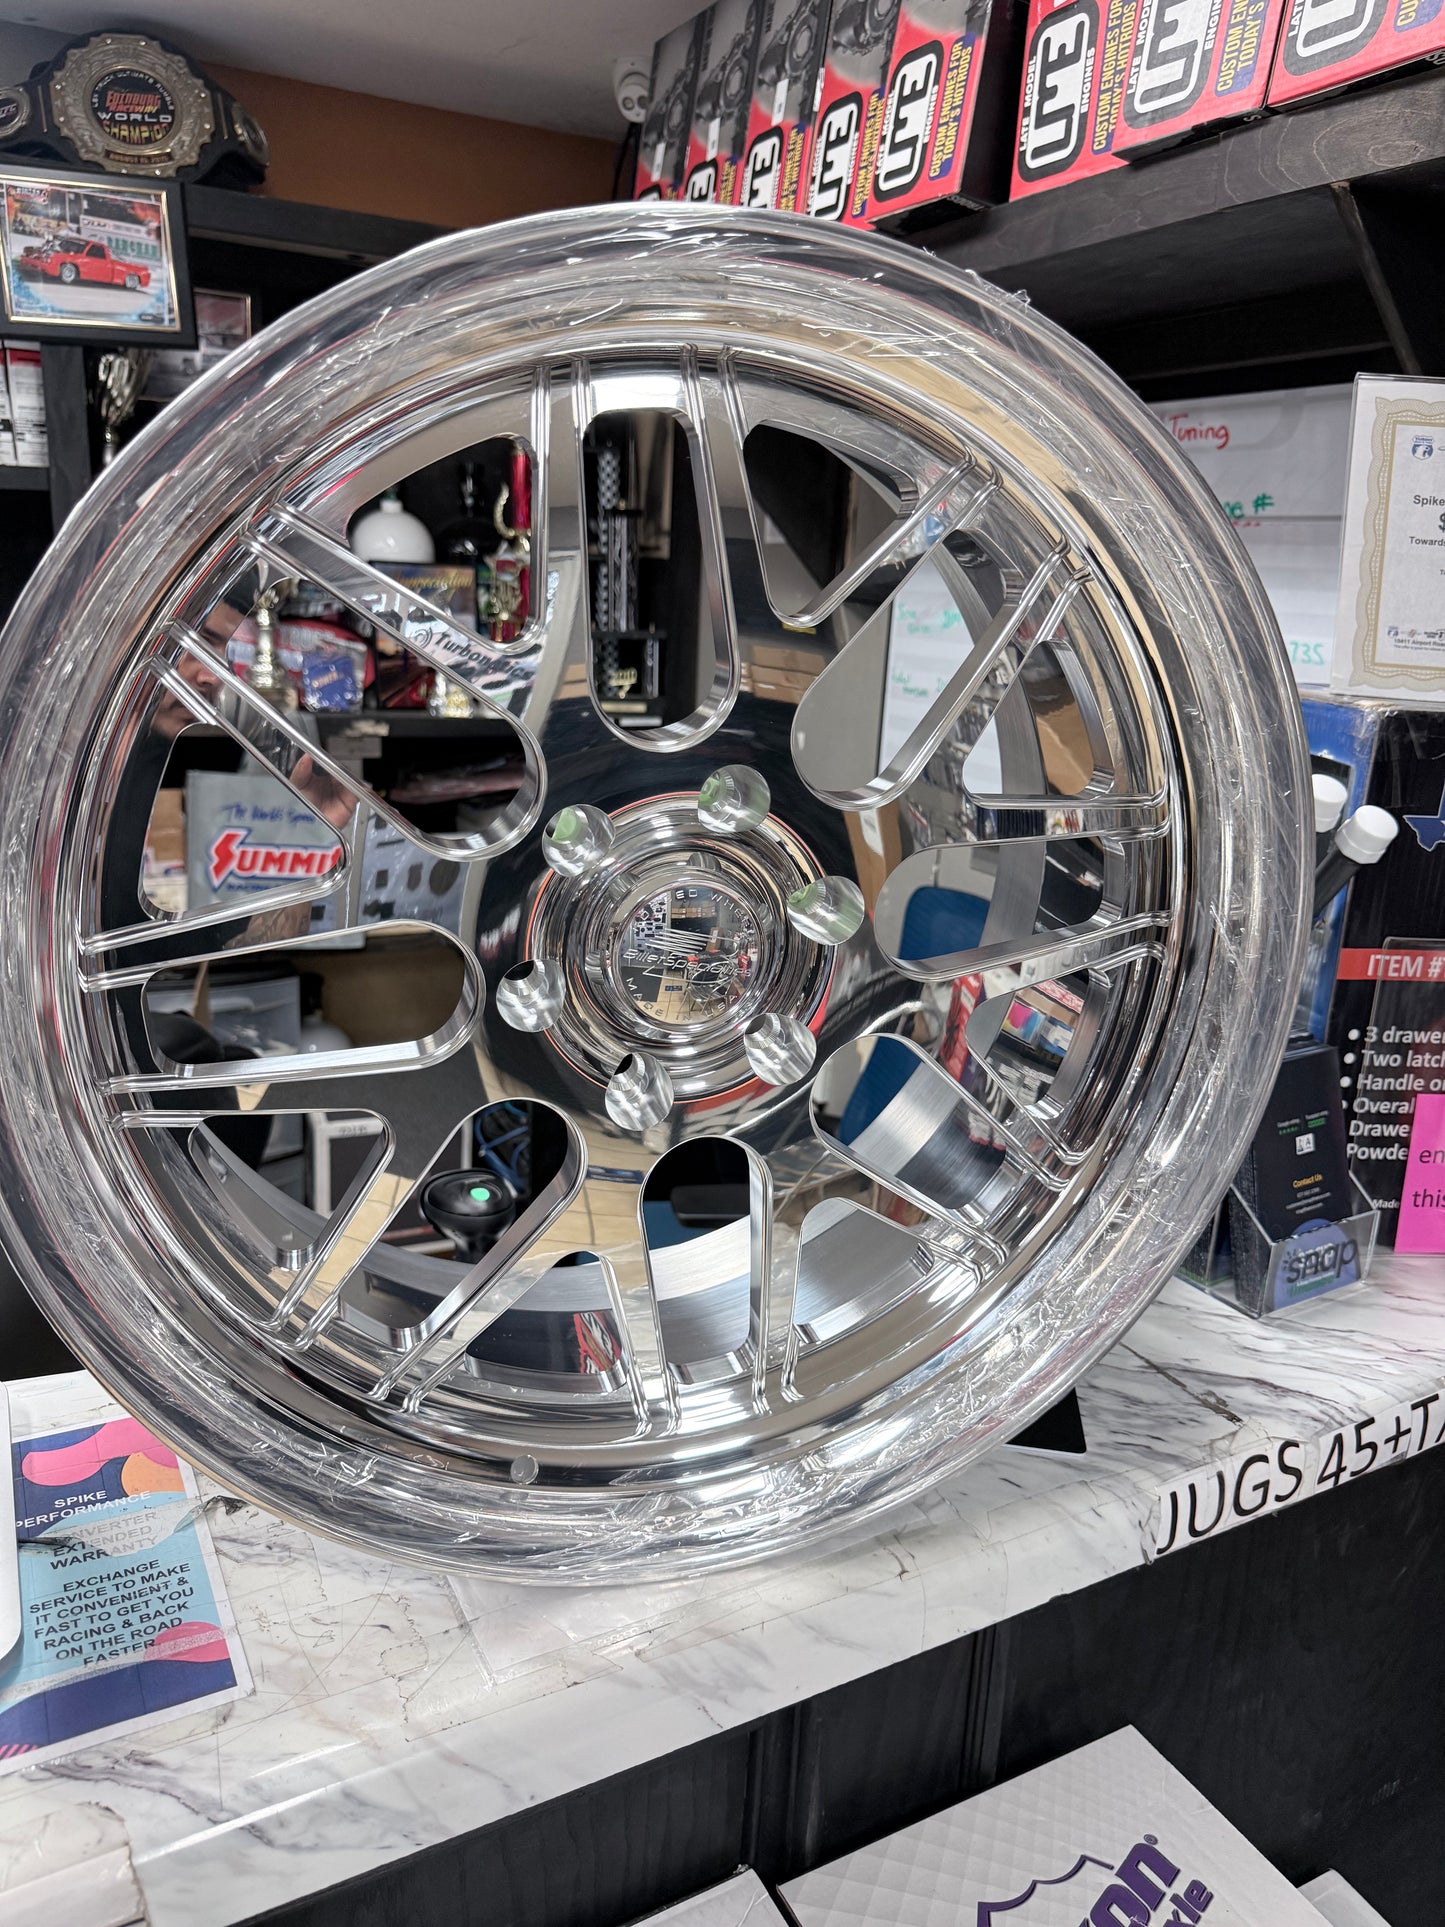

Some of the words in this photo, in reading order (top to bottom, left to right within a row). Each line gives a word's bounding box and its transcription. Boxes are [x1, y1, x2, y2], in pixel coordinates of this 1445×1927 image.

[1108, 0, 1123, 28] FOR
[1117, 2, 1136, 70] HOTRODS
[1127, 56, 1142, 94] LATE
[1136, 0, 1153, 45] MODE
[1237, 2, 1264, 71] TODAY'S
[1101, 29, 1119, 90] ENGINES
[1217, 24, 1243, 92] CUSTOM
[1024, 56, 1036, 107] MODEL
[1080, 47, 1095, 114] ENGINES
[97, 112, 172, 123] WORLD
[929, 126, 948, 177] CUSTOM
[939, 71, 957, 124] ENGINES
[950, 41, 963, 62] FOR
[942, 107, 960, 161] TODAY'S
[954, 46, 972, 106] HOTRODS
[1020, 117, 1030, 151] LATE
[1093, 93, 1110, 151] CUSTOM
[1168, 413, 1230, 450] Tuning
[1413, 494, 1445, 508] Spike
[1367, 954, 1424, 978] ITEM
[1364, 1026, 1378, 1043] 3
[1361, 1050, 1401, 1067] Two
[1357, 1074, 1425, 1091] Handle
[1352, 1097, 1416, 1114] Overal
[1349, 1120, 1411, 1137] Drawe
[1346, 1143, 1409, 1161] Powde
[1293, 1176, 1315, 1188] Contact
[1372, 1199, 1400, 1209] Made
[54, 1490, 108, 1508] SPIKE
[1156, 1440, 1303, 1555] JUGS
[50, 1535, 160, 1570] WARRANTY
[29, 1587, 107, 1614] SERVICE
[111, 1579, 136, 1592] TO
[141, 1563, 191, 1585] MAKE
[63, 1559, 160, 1592] EXCHANGE
[34, 1618, 82, 1639] FAST
[86, 1611, 112, 1625] TO
[117, 1599, 152, 1617] GET
[157, 1586, 194, 1605] YOU
[35, 1613, 51, 1625] IT
[57, 1580, 172, 1619] CONVENIENT
[177, 1576, 190, 1586] &
[43, 1622, 116, 1650] RACING
[121, 1618, 134, 1629] &
[139, 1601, 191, 1624] BACK
[55, 1645, 84, 1661] ON
[88, 1633, 126, 1651] THE
[130, 1617, 184, 1643] ROAD
[83, 1638, 156, 1666] FASTER
